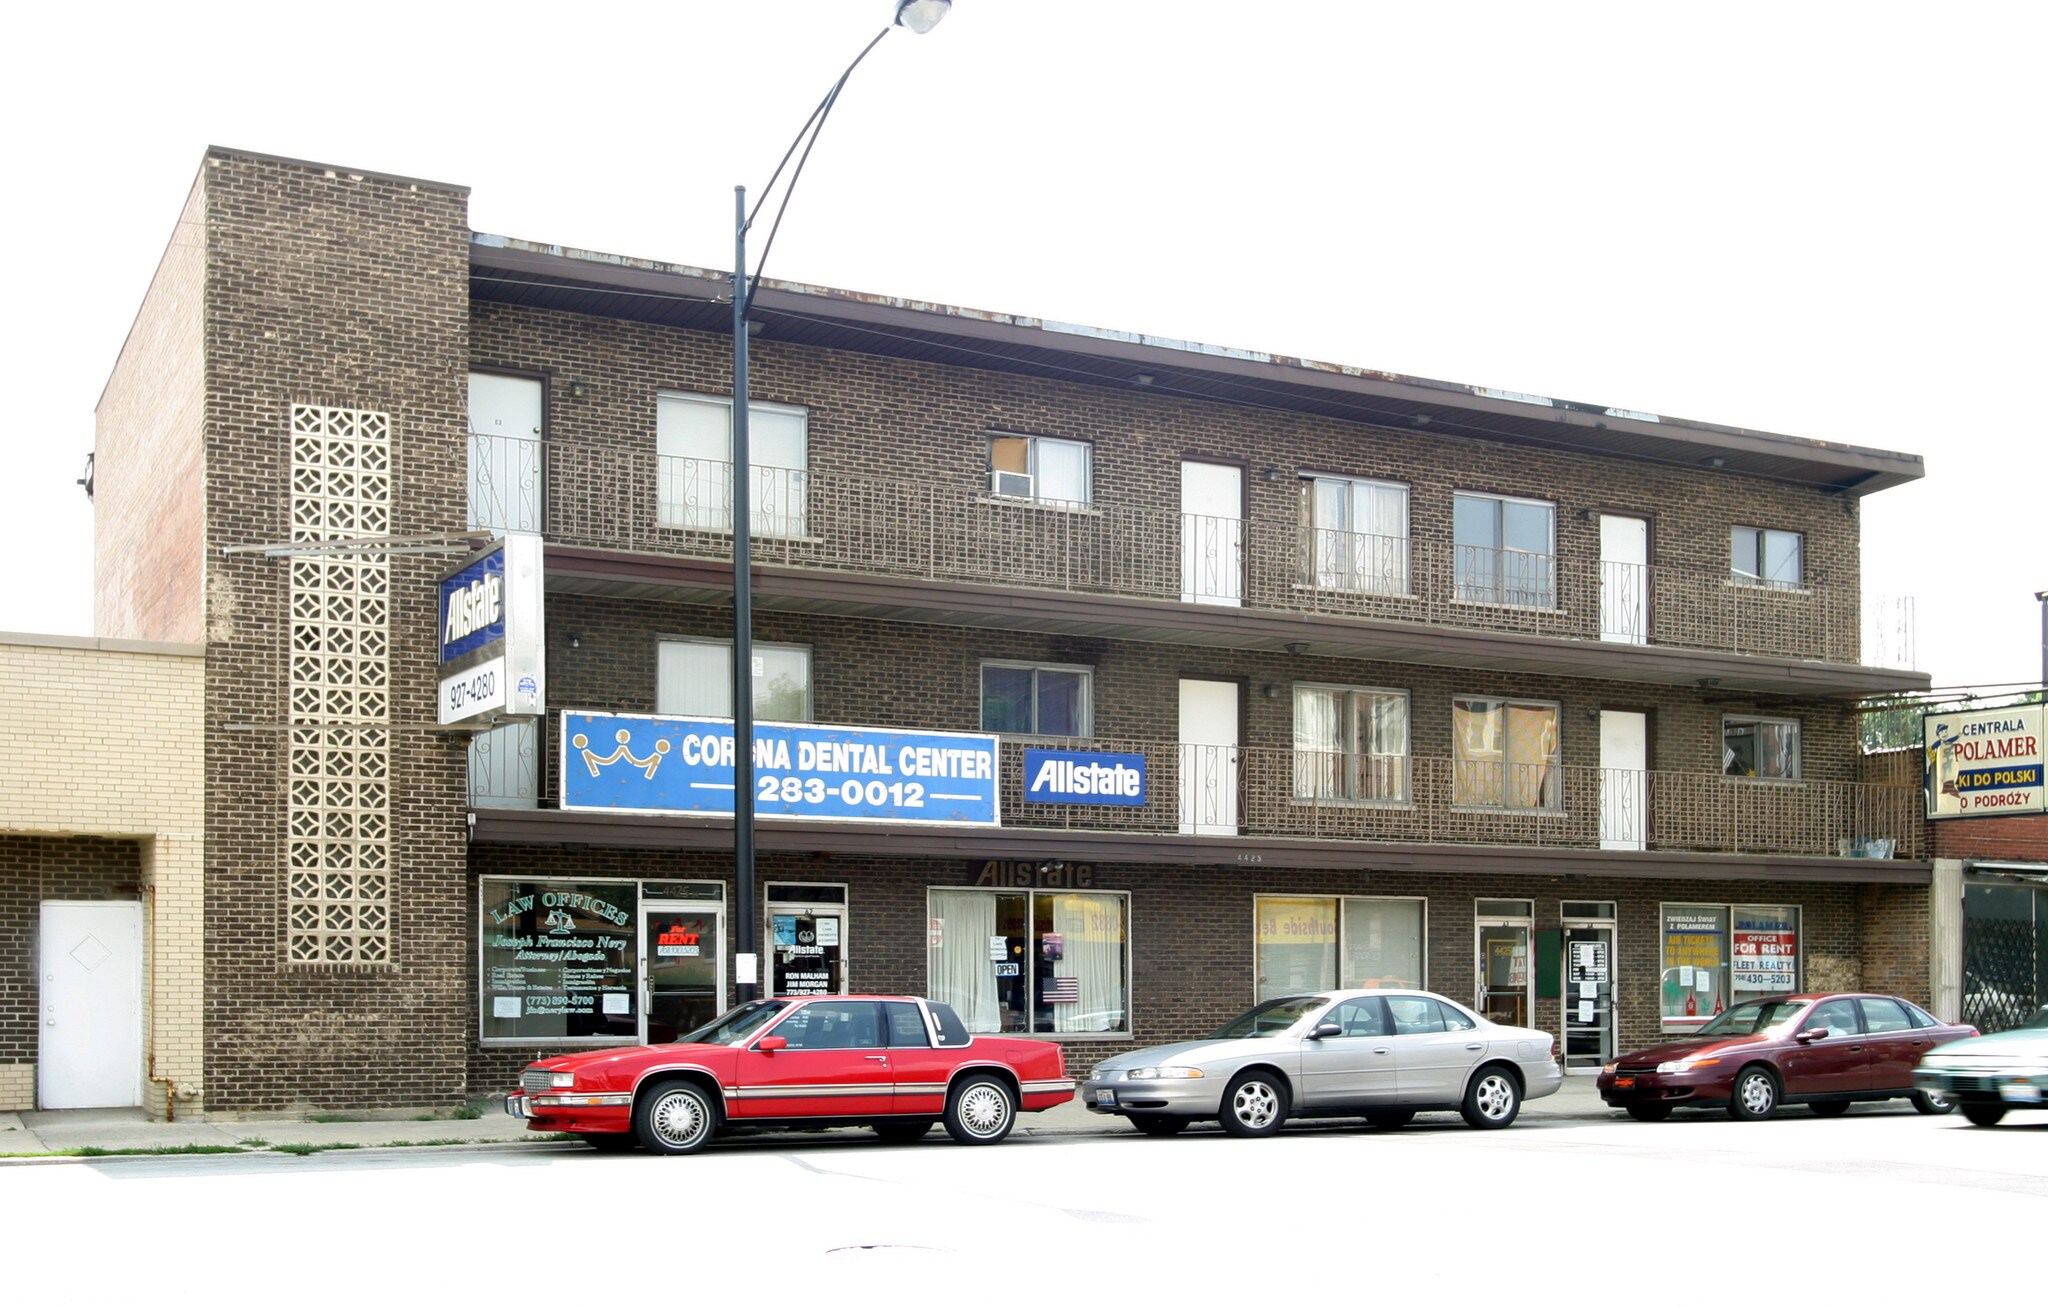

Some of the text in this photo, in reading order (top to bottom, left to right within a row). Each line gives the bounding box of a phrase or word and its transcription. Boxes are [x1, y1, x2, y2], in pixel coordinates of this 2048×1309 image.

[445, 573, 500, 644] Allstate
[451, 671, 494, 710] 927-4280
[1962, 719, 2024, 735] CENTRALA
[683, 734, 991, 779] CORNA DENTAL CENTER
[1954, 736, 2037, 761] POLAMER
[1030, 760, 1140, 796] Allstate
[1956, 769, 2036, 787] KI DO POLSKI
[758, 776, 924, 807] 283-0012
[1975, 791, 2031, 808] PODRÓŻY
[974, 860, 1092, 888] Allstate
[490, 892, 629, 926] LAW OFFICES
[492, 934, 627, 950] Joseph Francisco Nery
[658, 933, 699, 945] RENT
[788, 945, 824, 954] Allstate
[1735, 944, 1792, 954] FOR RENT
[997, 964, 1017, 974] OPEN
[1759, 961, 1791, 970] REALTY
